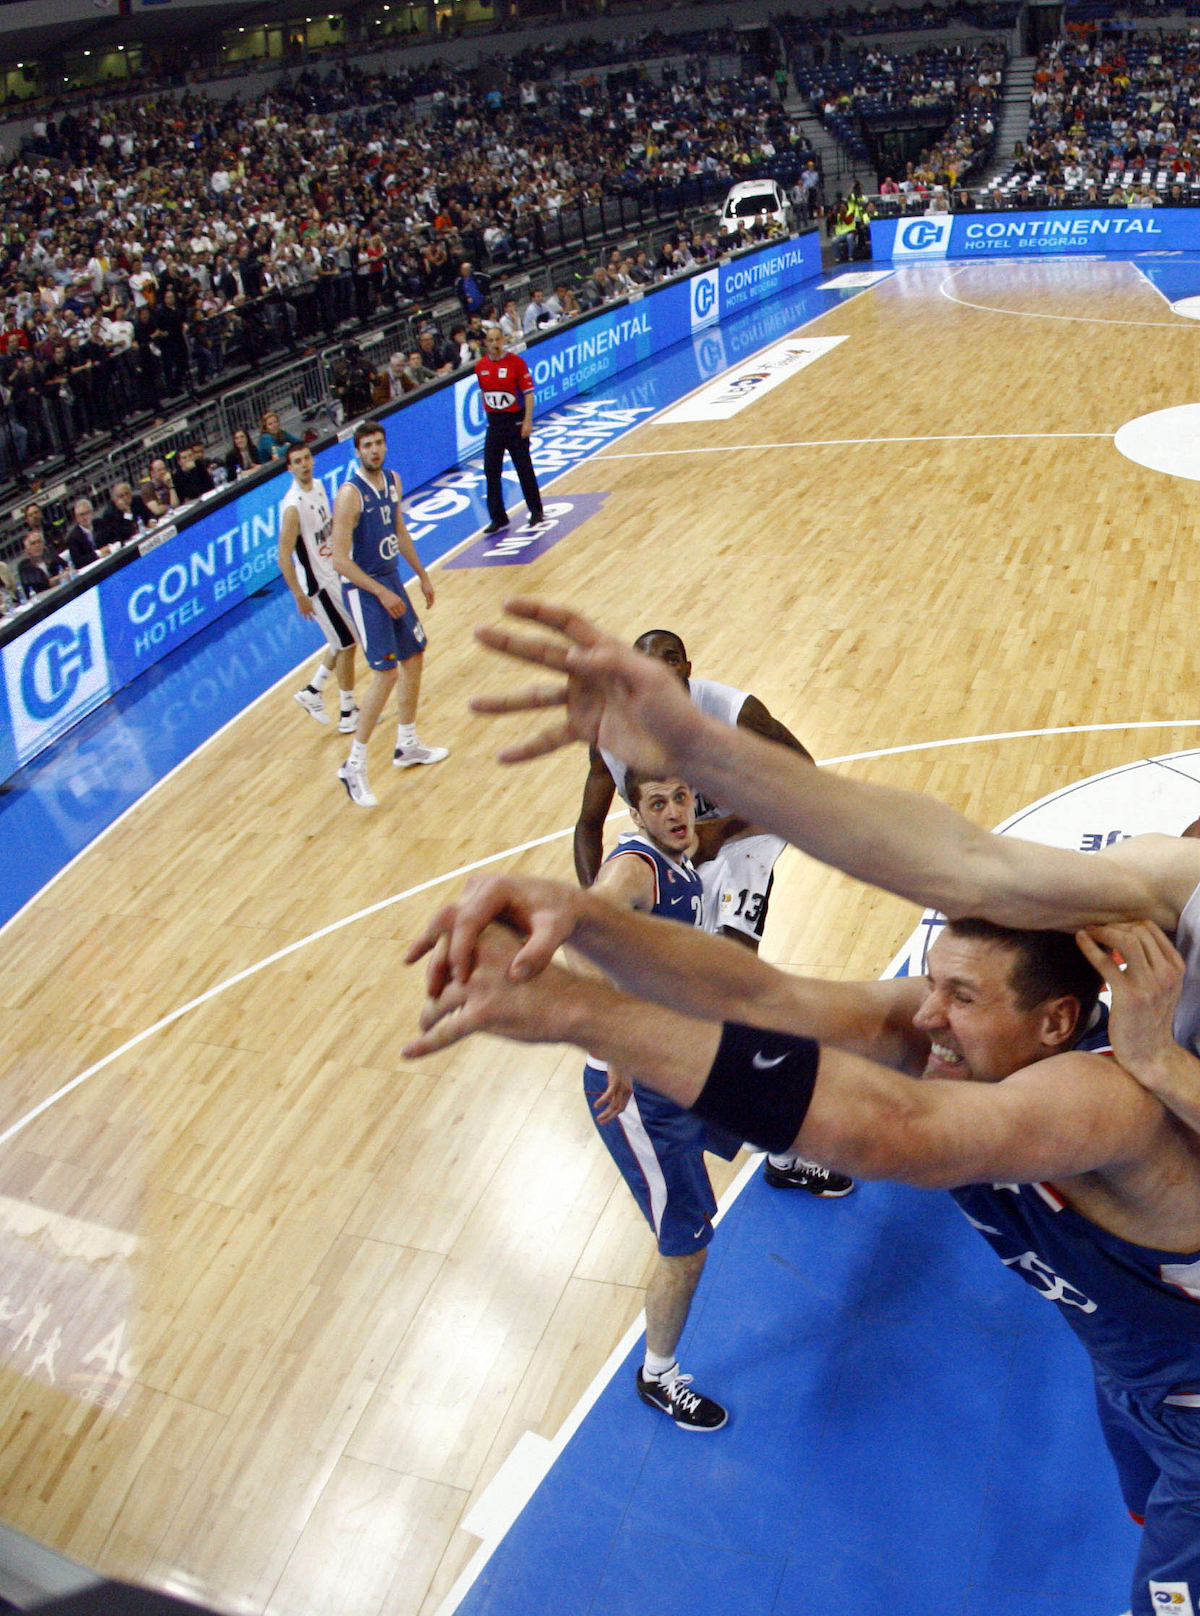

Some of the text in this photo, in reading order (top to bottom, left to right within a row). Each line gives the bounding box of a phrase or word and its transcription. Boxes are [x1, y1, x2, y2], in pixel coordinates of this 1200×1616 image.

[966, 218, 1162, 239] CONTINENTAL
[964, 236, 1088, 250] HOTEL BEOGRAD
[725, 249, 804, 293] CONTINENTAL
[750, 277, 779, 298] BEOGRAD
[528, 313, 652, 384] ONTINENTAL
[533, 385, 558, 406] OTEL
[562, 357, 610, 392] BEOGRAD
[484, 393, 516, 408] KIA
[379, 505, 392, 525] 12
[134, 545, 280, 658] HOTEL BEOGR
[734, 888, 766, 922] 13
